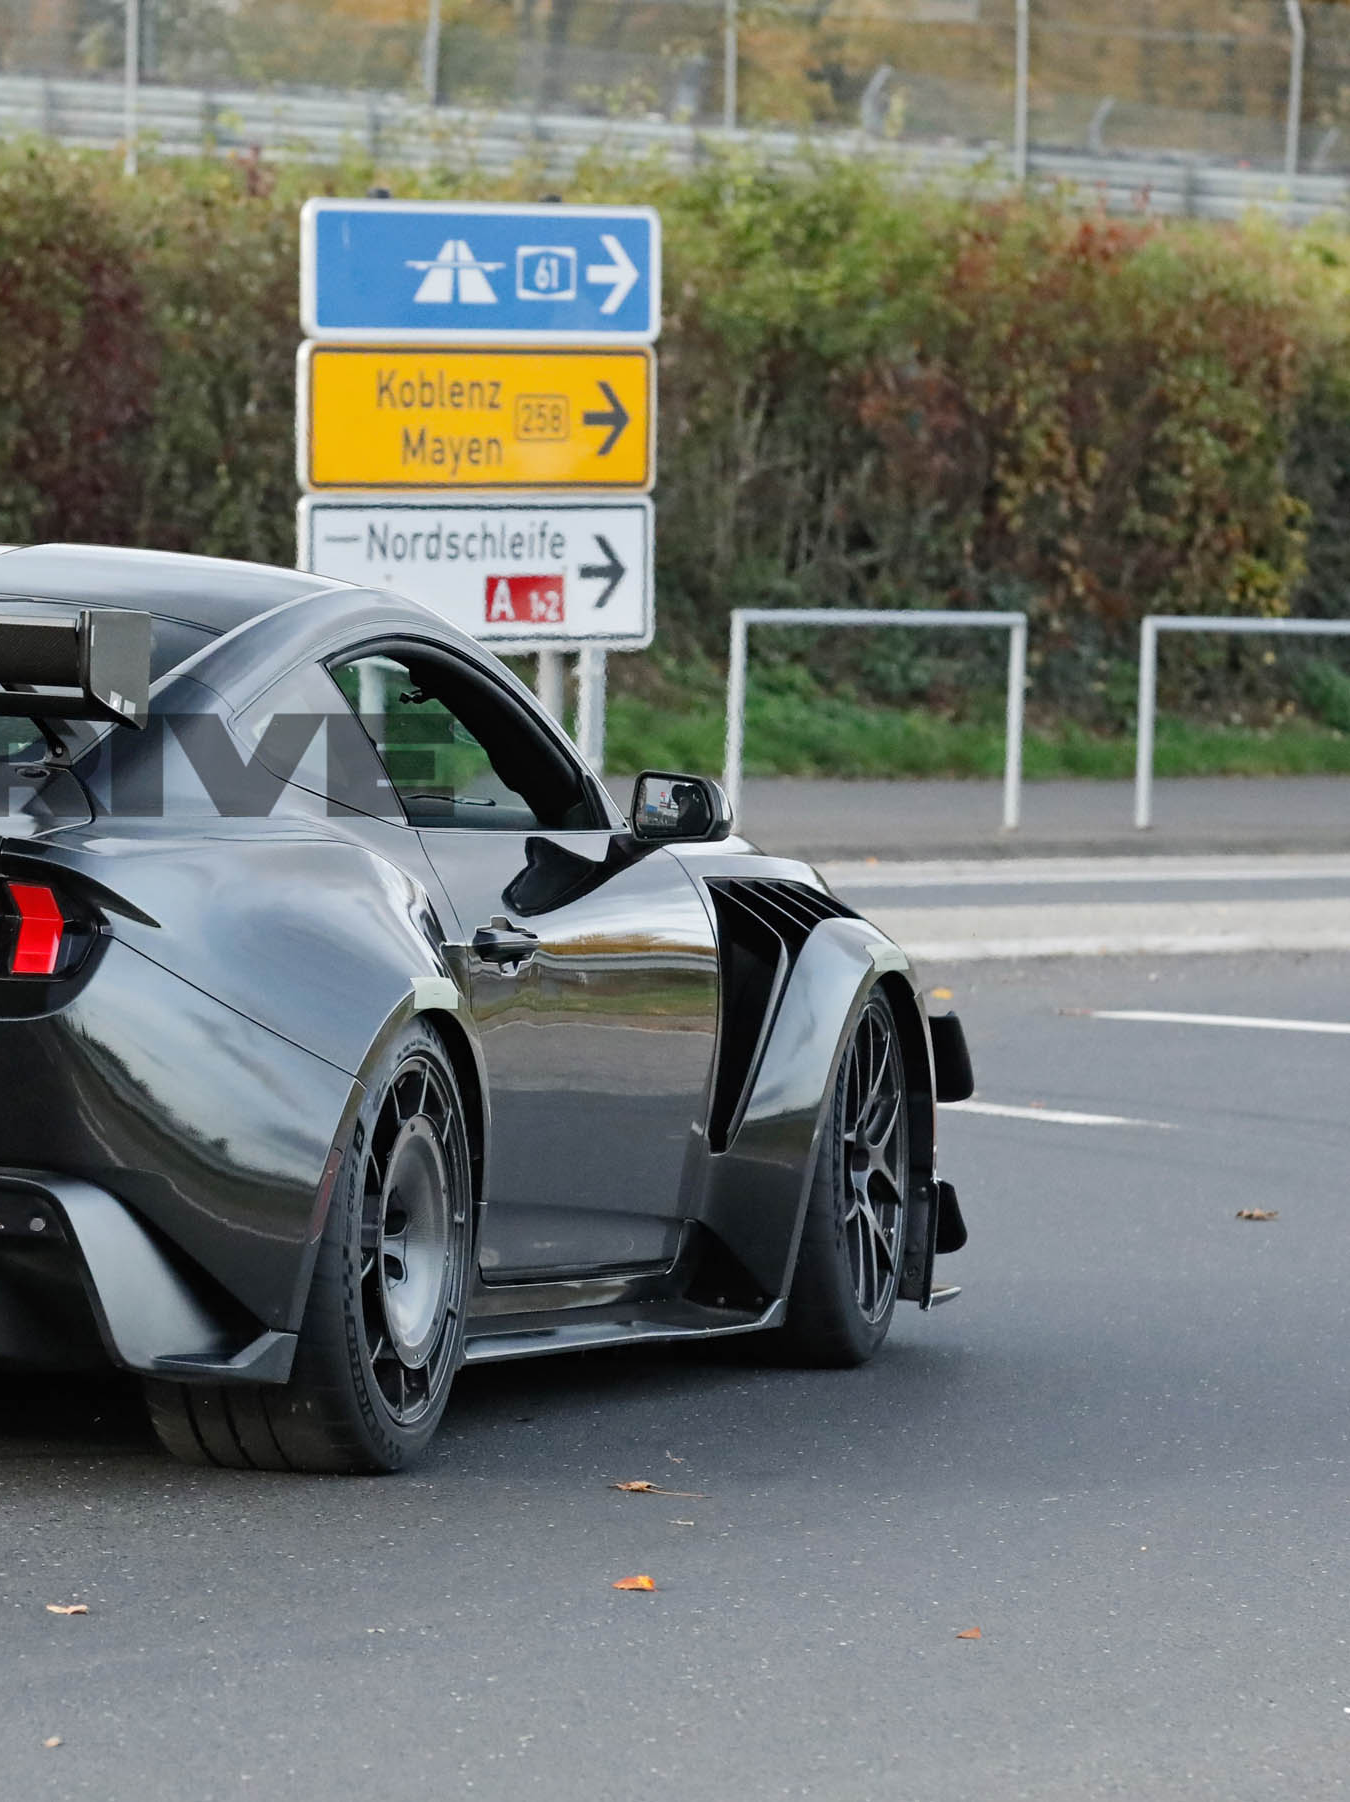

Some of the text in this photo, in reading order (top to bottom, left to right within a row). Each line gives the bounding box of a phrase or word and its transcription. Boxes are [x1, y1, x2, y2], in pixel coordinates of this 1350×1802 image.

[534, 257, 559, 290] 61
[375, 368, 503, 409] Koblenz
[521, 403, 563, 433] 258
[402, 425, 503, 477] Mayen
[366, 521, 566, 562] Nordschleife
[490, 578, 515, 620] A
